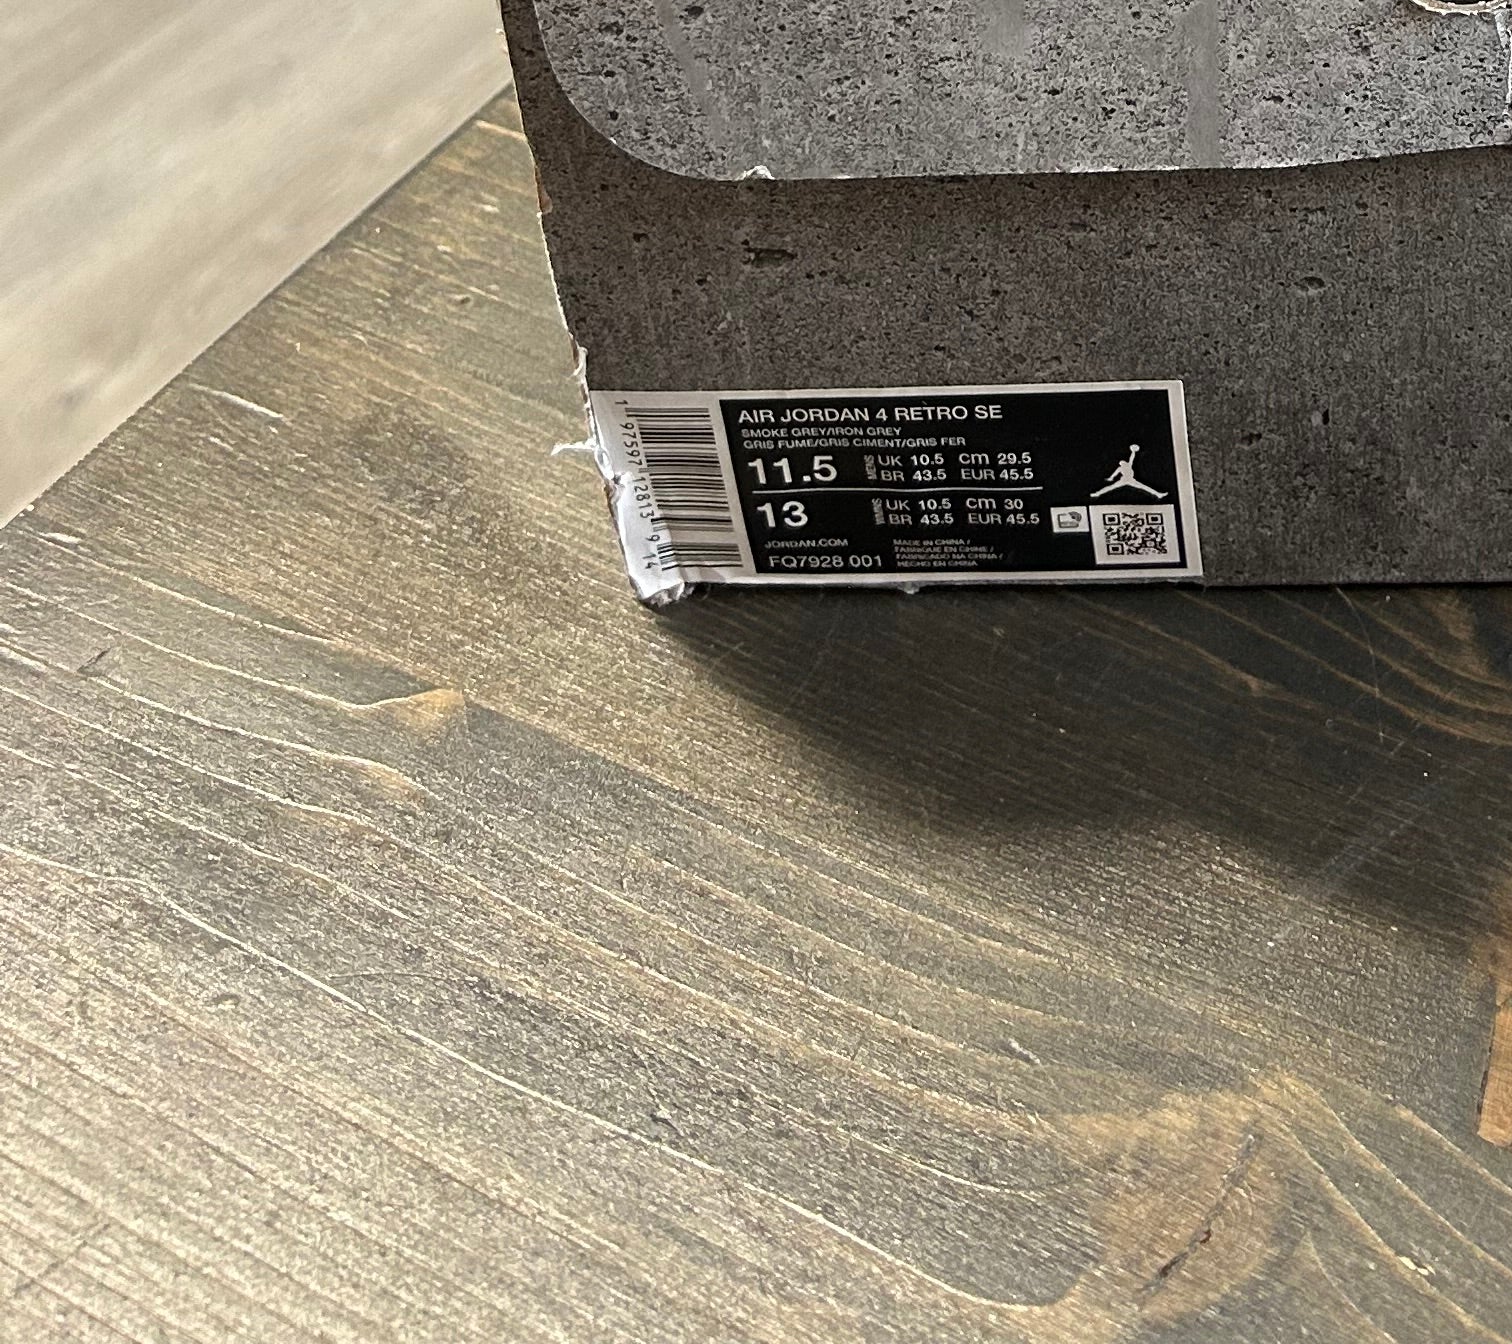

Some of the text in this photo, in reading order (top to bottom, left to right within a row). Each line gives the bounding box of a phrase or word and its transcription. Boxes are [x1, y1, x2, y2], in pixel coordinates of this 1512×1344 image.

[738, 404, 1003, 424] AIR JORDAN 4 RETRO SE
[742, 426, 902, 438] SMOKE GREY/IRON GREY
[620, 423, 643, 467] 97597
[743, 439, 774, 450] GRIS
[853, 437, 937, 448] CIMENT/GRIS
[940, 436, 966, 447] FER
[878, 455, 902, 466] UK
[910, 454, 944, 466] 10.5
[997, 452, 1032, 464] 29.5
[748, 455, 838, 485] 11.5
[881, 468, 1034, 481] BR 43.5 EUR 45.5
[631, 476, 655, 519] 12813
[886, 499, 910, 511] UK
[918, 498, 952, 510] 10.5
[1004, 498, 1023, 510] 30
[757, 500, 808, 528] 13
[889, 512, 1040, 525] BR 43.5 EUR 45.5
[764, 538, 849, 549] JORDAN.COM
[769, 555, 882, 568] FQ7928 001
